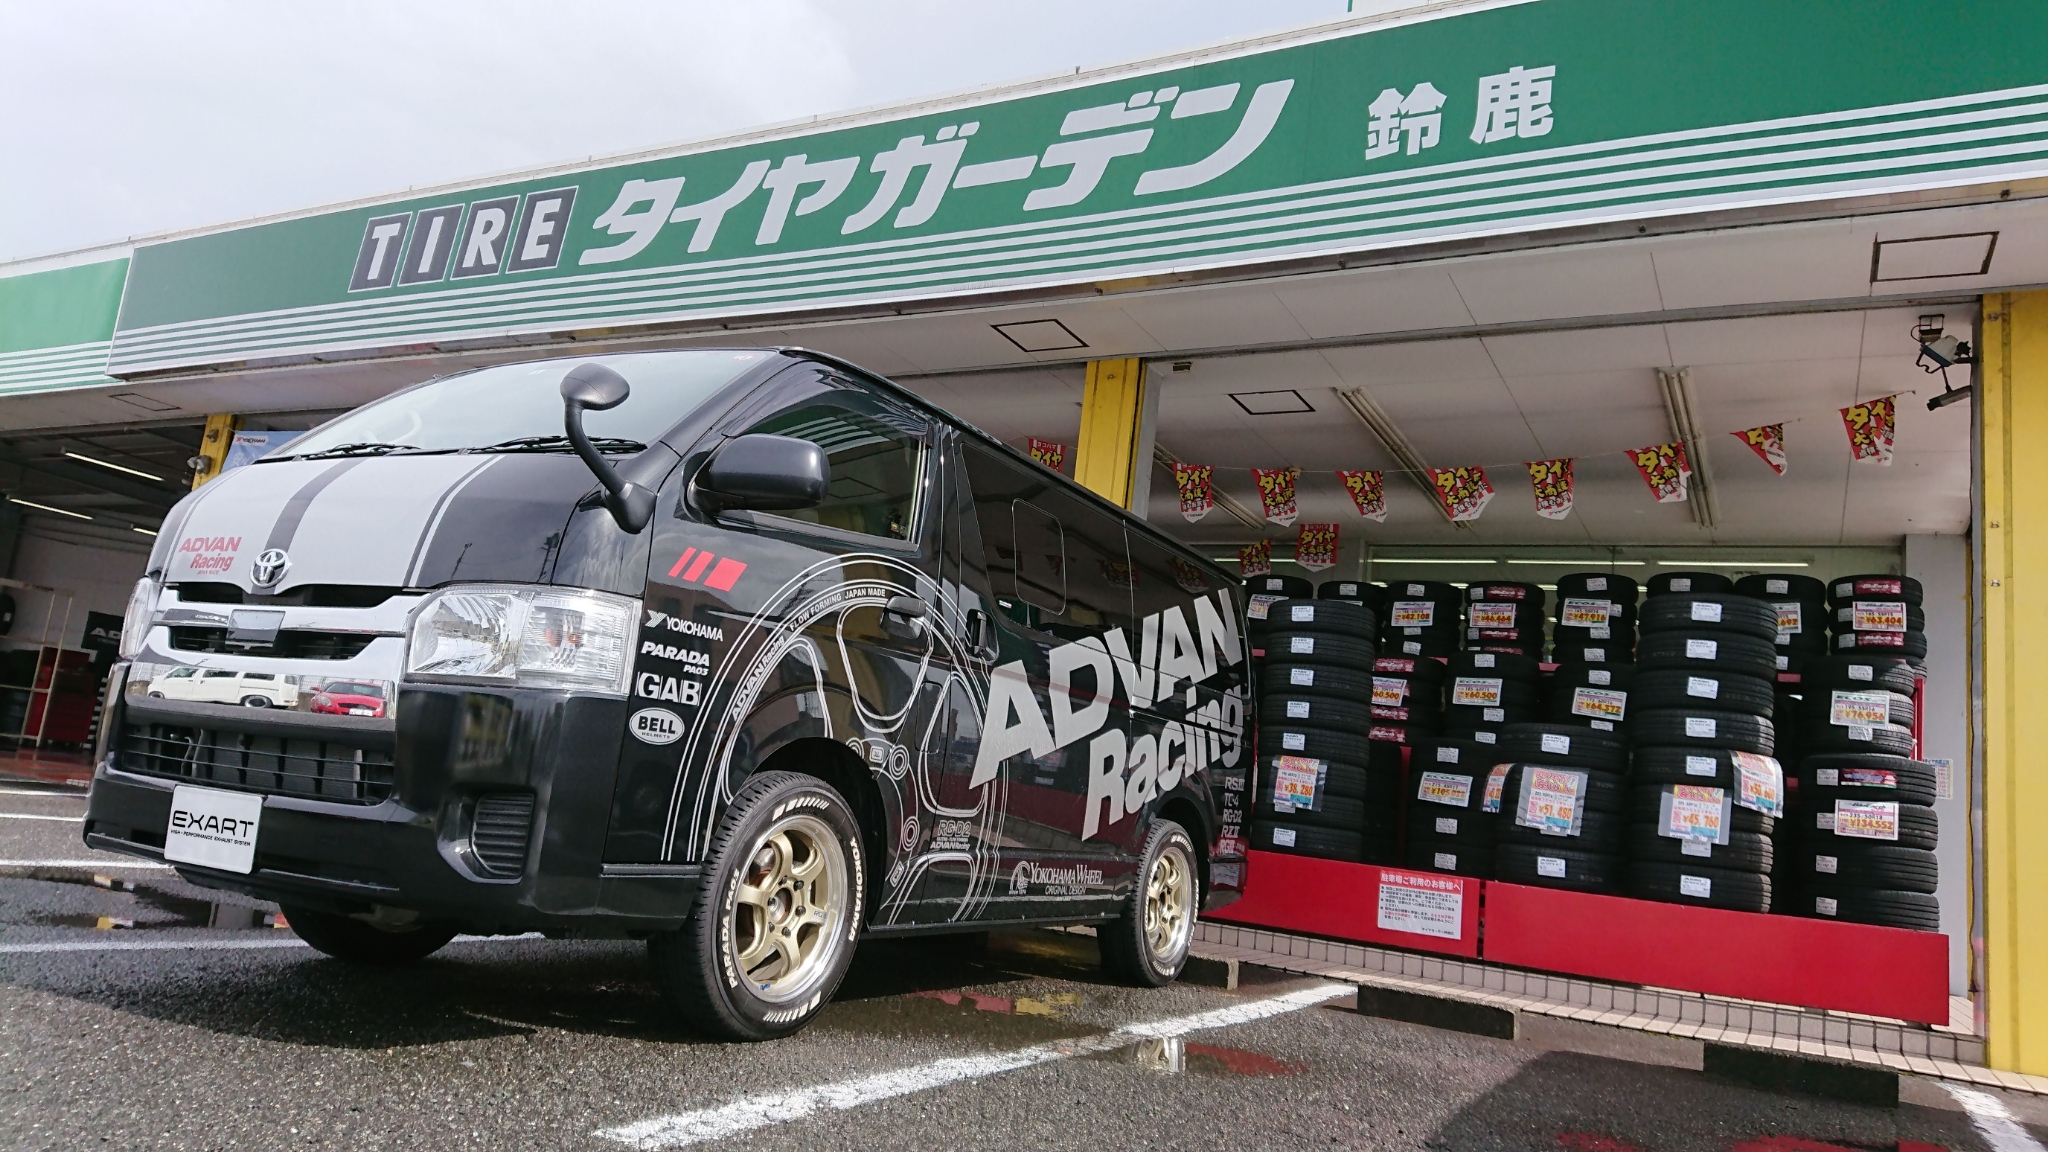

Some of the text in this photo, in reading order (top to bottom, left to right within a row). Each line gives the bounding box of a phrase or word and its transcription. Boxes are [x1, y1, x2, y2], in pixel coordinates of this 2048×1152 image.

[578, 65, 1557, 266] タイヤガーデン 鈴鹿
[367, 197, 563, 280] TIRE
[1031, 447, 1062, 467] タイヤ
[1037, 441, 1057, 449] ヨコハマ
[178, 536, 242, 553] ADVAN
[1301, 530, 1336, 544] タイヤ
[190, 553, 235, 572] Racing
[789, 587, 886, 632] FLOW FORMING JAPAN MADE
[666, 616, 724, 642] YOKOHAMA
[641, 641, 710, 667] PARADA
[683, 664, 709, 676] PA03
[731, 635, 786, 722] ADVAN Racing
[635, 671, 702, 707] GAB
[968, 587, 1243, 790] ADVAN
[638, 715, 676, 735] BELL
[1082, 686, 1244, 842] Racing
[172, 810, 254, 838] EXART
[930, 841, 955, 850] ADVAN
[1030, 862, 1105, 885] YOKOHAMA WHEEL
[848, 837, 863, 942] YOKOHAMA
[1044, 885, 1087, 895] ORIGINAL DESIGN
[721, 868, 740, 989] PARADA PA03
